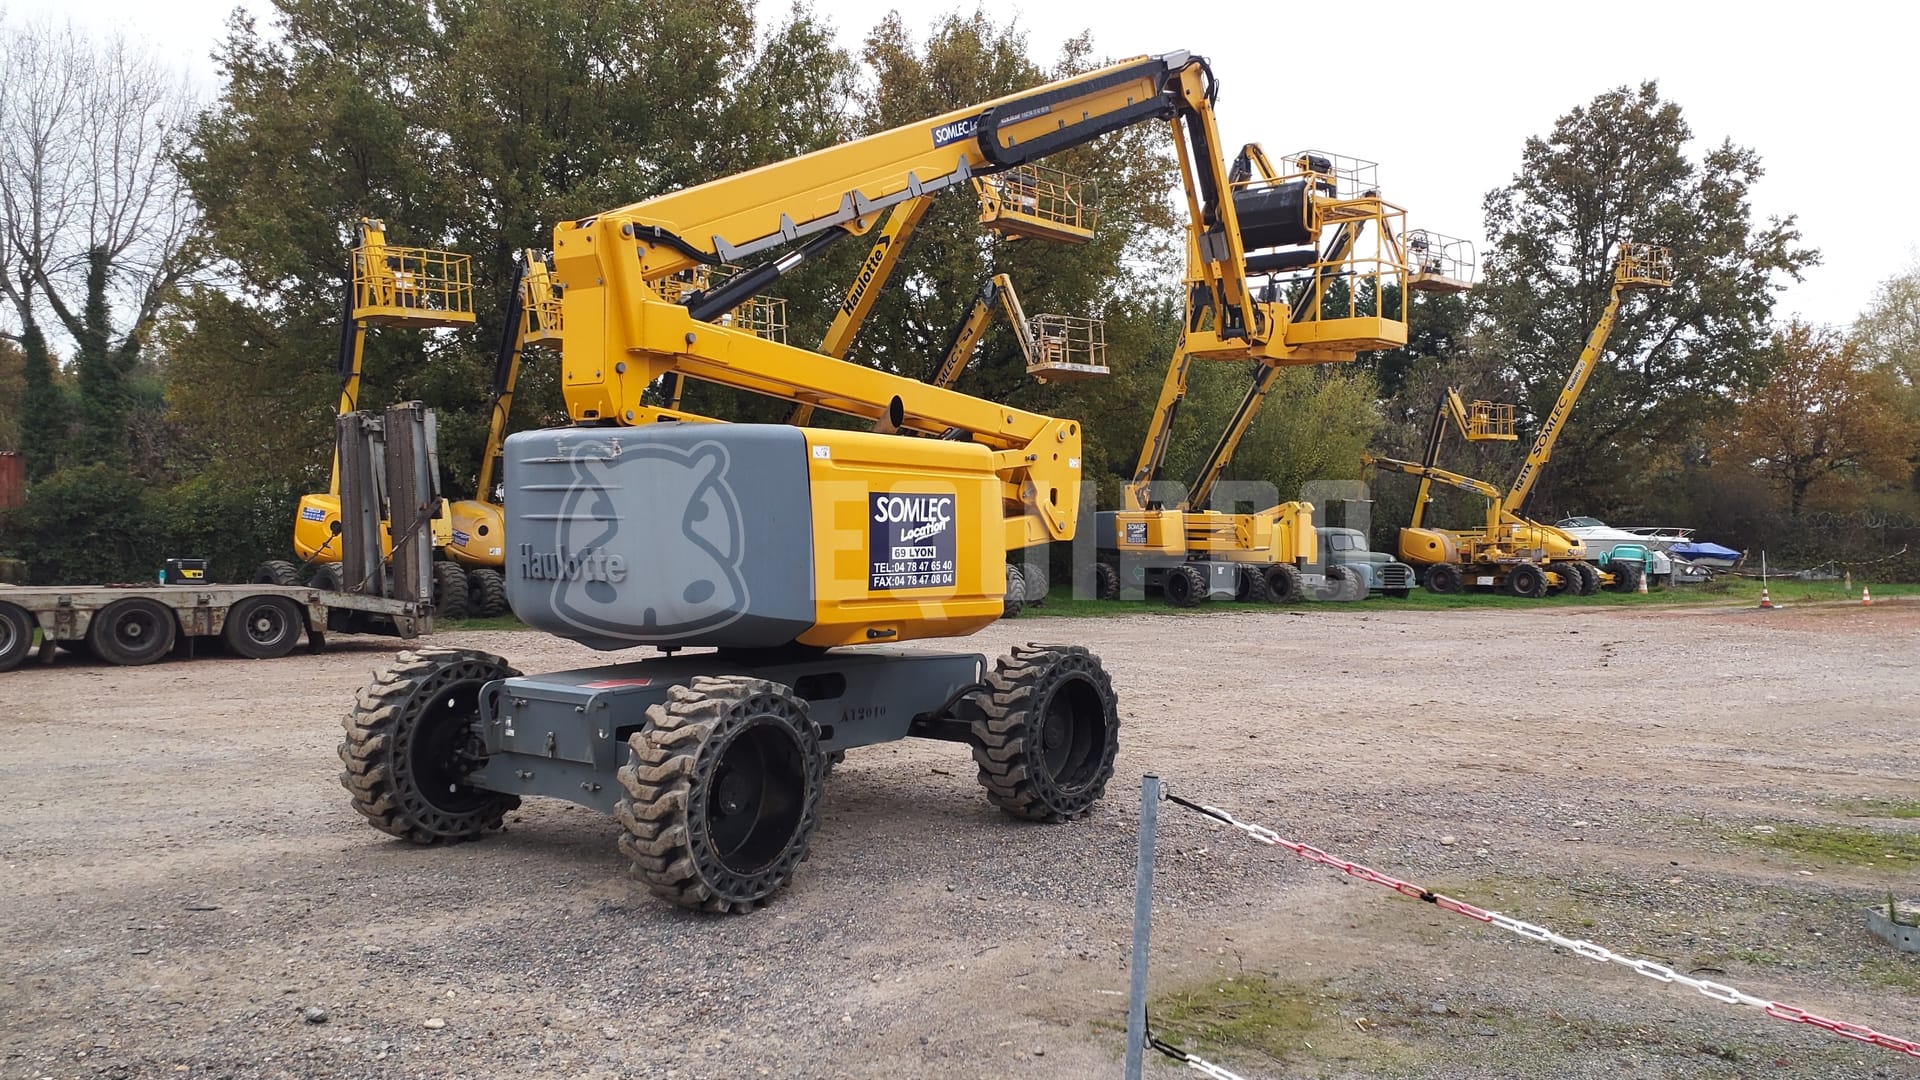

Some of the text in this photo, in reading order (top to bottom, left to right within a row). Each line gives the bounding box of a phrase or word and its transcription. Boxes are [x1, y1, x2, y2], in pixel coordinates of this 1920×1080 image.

[935, 121, 969, 143] SOMLEC
[842, 250, 883, 317] Haulotte
[935, 351, 959, 388] MLEC
[1533, 396, 1568, 458] SOMLEC
[1514, 463, 1533, 492] H21TX
[874, 496, 951, 523] SOMLEC
[900, 520, 948, 542] Location
[518, 543, 627, 582] Haulotte
[894, 547, 934, 558] 69 LYON
[907, 561, 917, 572] 78
[919, 561, 928, 571] 47
[931, 560, 941, 571] 65
[942, 560, 952, 570] 40
[907, 575, 917, 585] 78
[919, 575, 928, 585] 47
[931, 574, 941, 584] 08
[942, 573, 952, 583] 04
